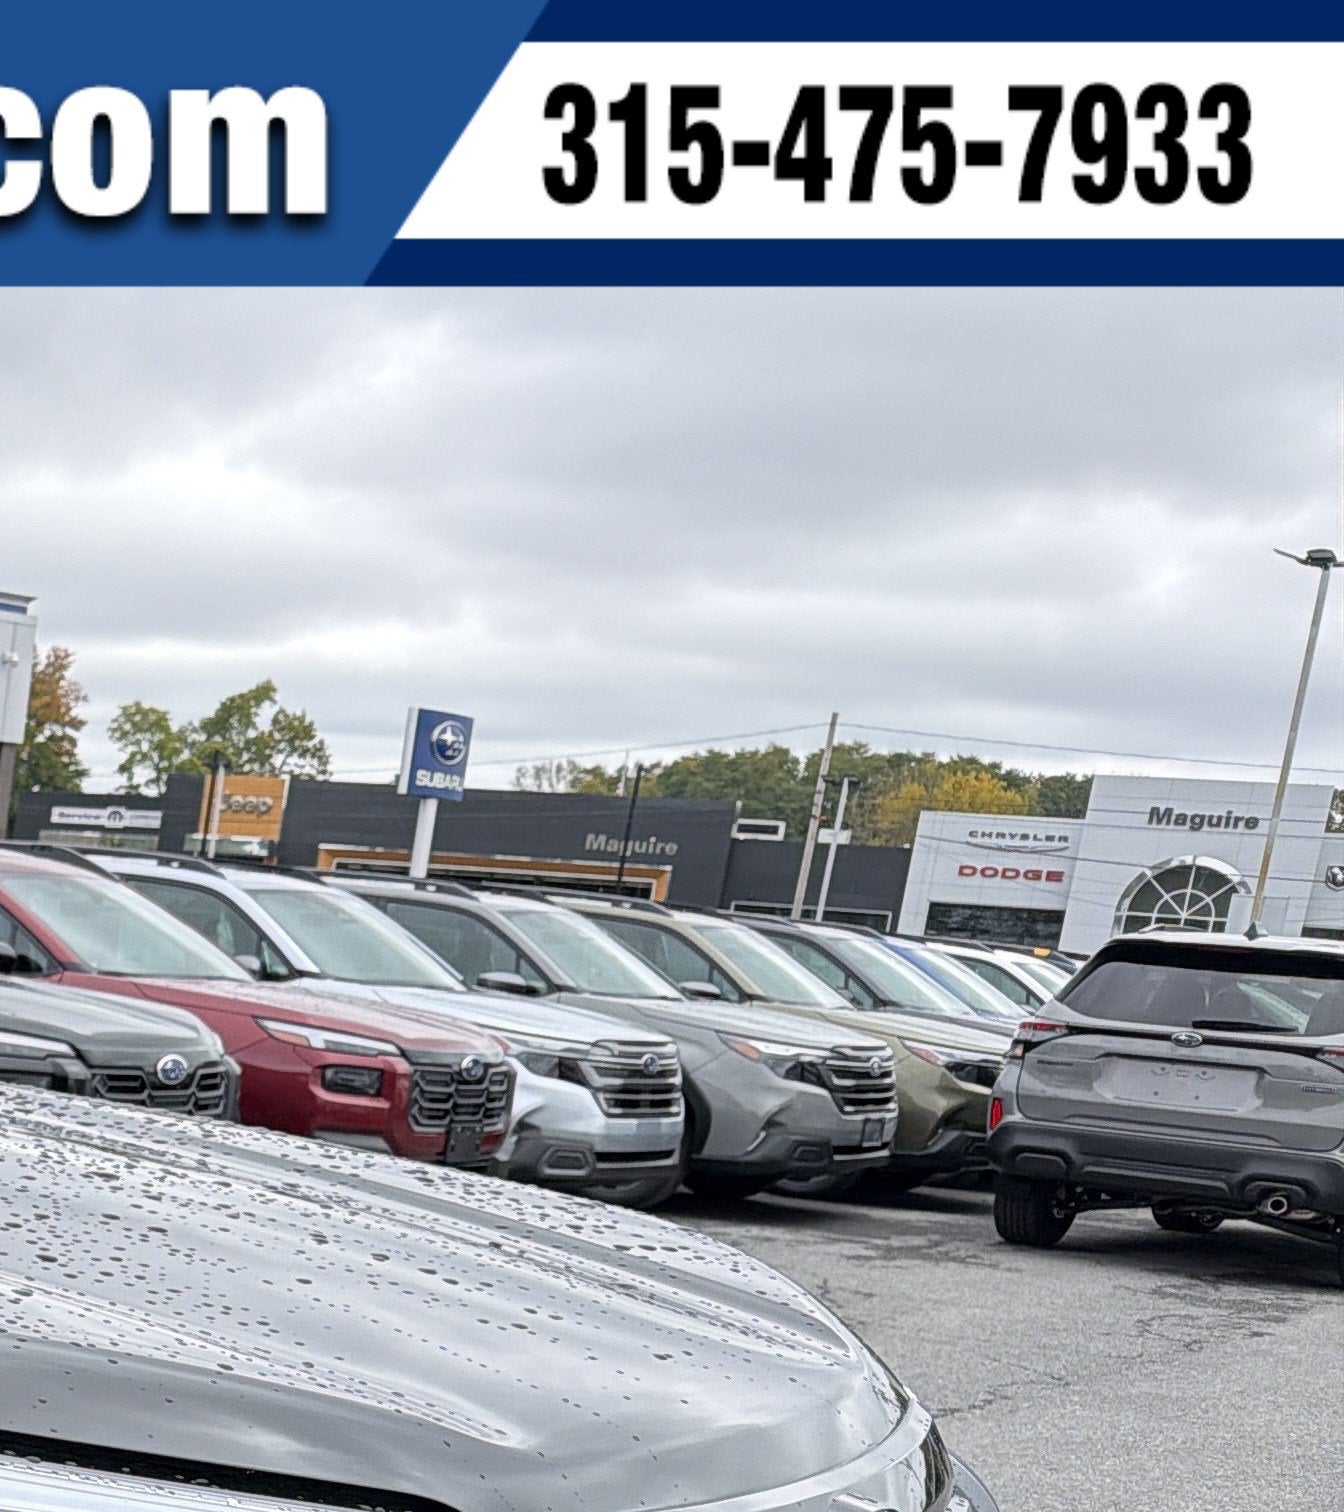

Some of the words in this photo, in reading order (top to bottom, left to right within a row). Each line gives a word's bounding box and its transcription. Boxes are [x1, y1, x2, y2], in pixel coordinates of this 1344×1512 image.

[1147, 806, 1260, 832] Maguire
[584, 833, 678, 857] Maguire
[968, 829, 1070, 844] CHRYSLER
[957, 864, 1066, 883] DODGE
